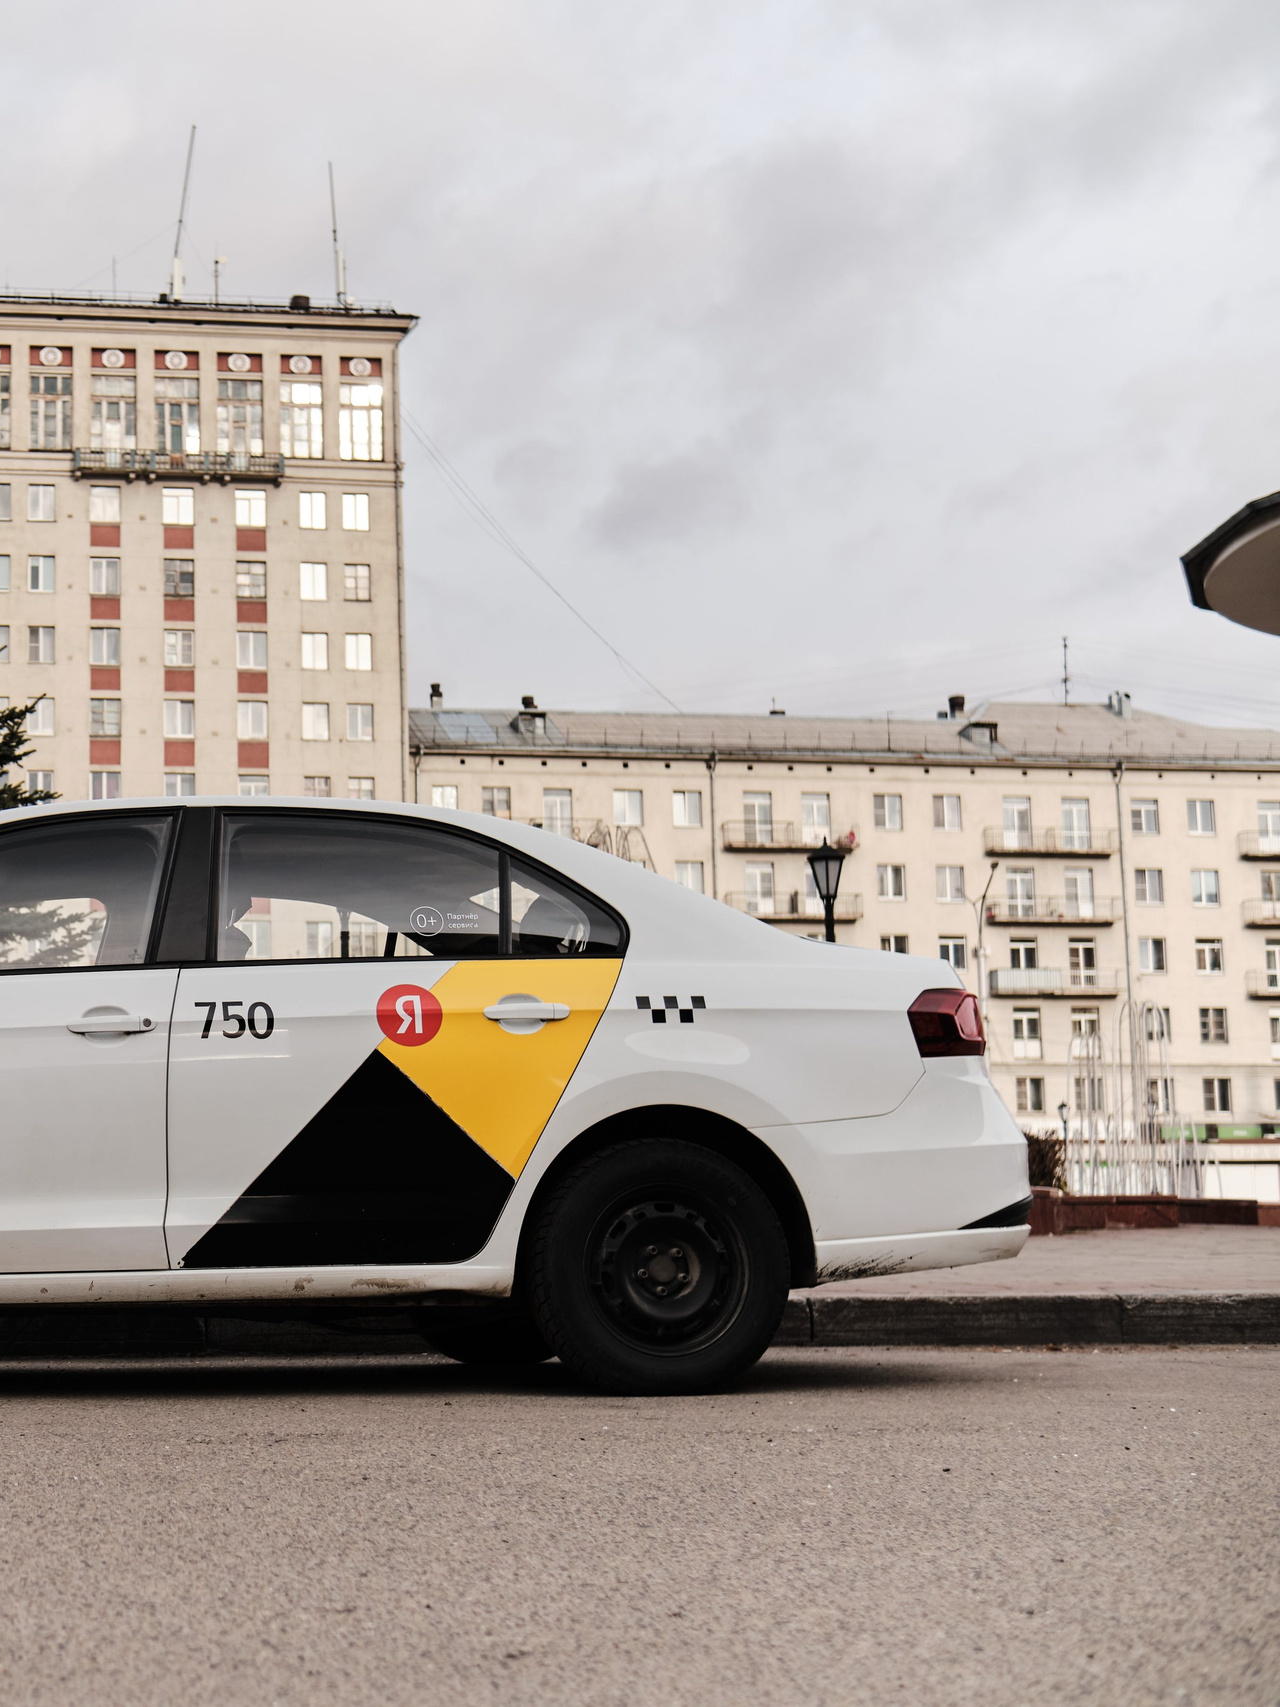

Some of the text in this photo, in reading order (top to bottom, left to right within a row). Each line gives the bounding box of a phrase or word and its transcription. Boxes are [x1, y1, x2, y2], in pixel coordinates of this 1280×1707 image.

[416, 914, 437, 928] 0+
[194, 1000, 275, 1040] 750
[394, 994, 424, 1034] Я
